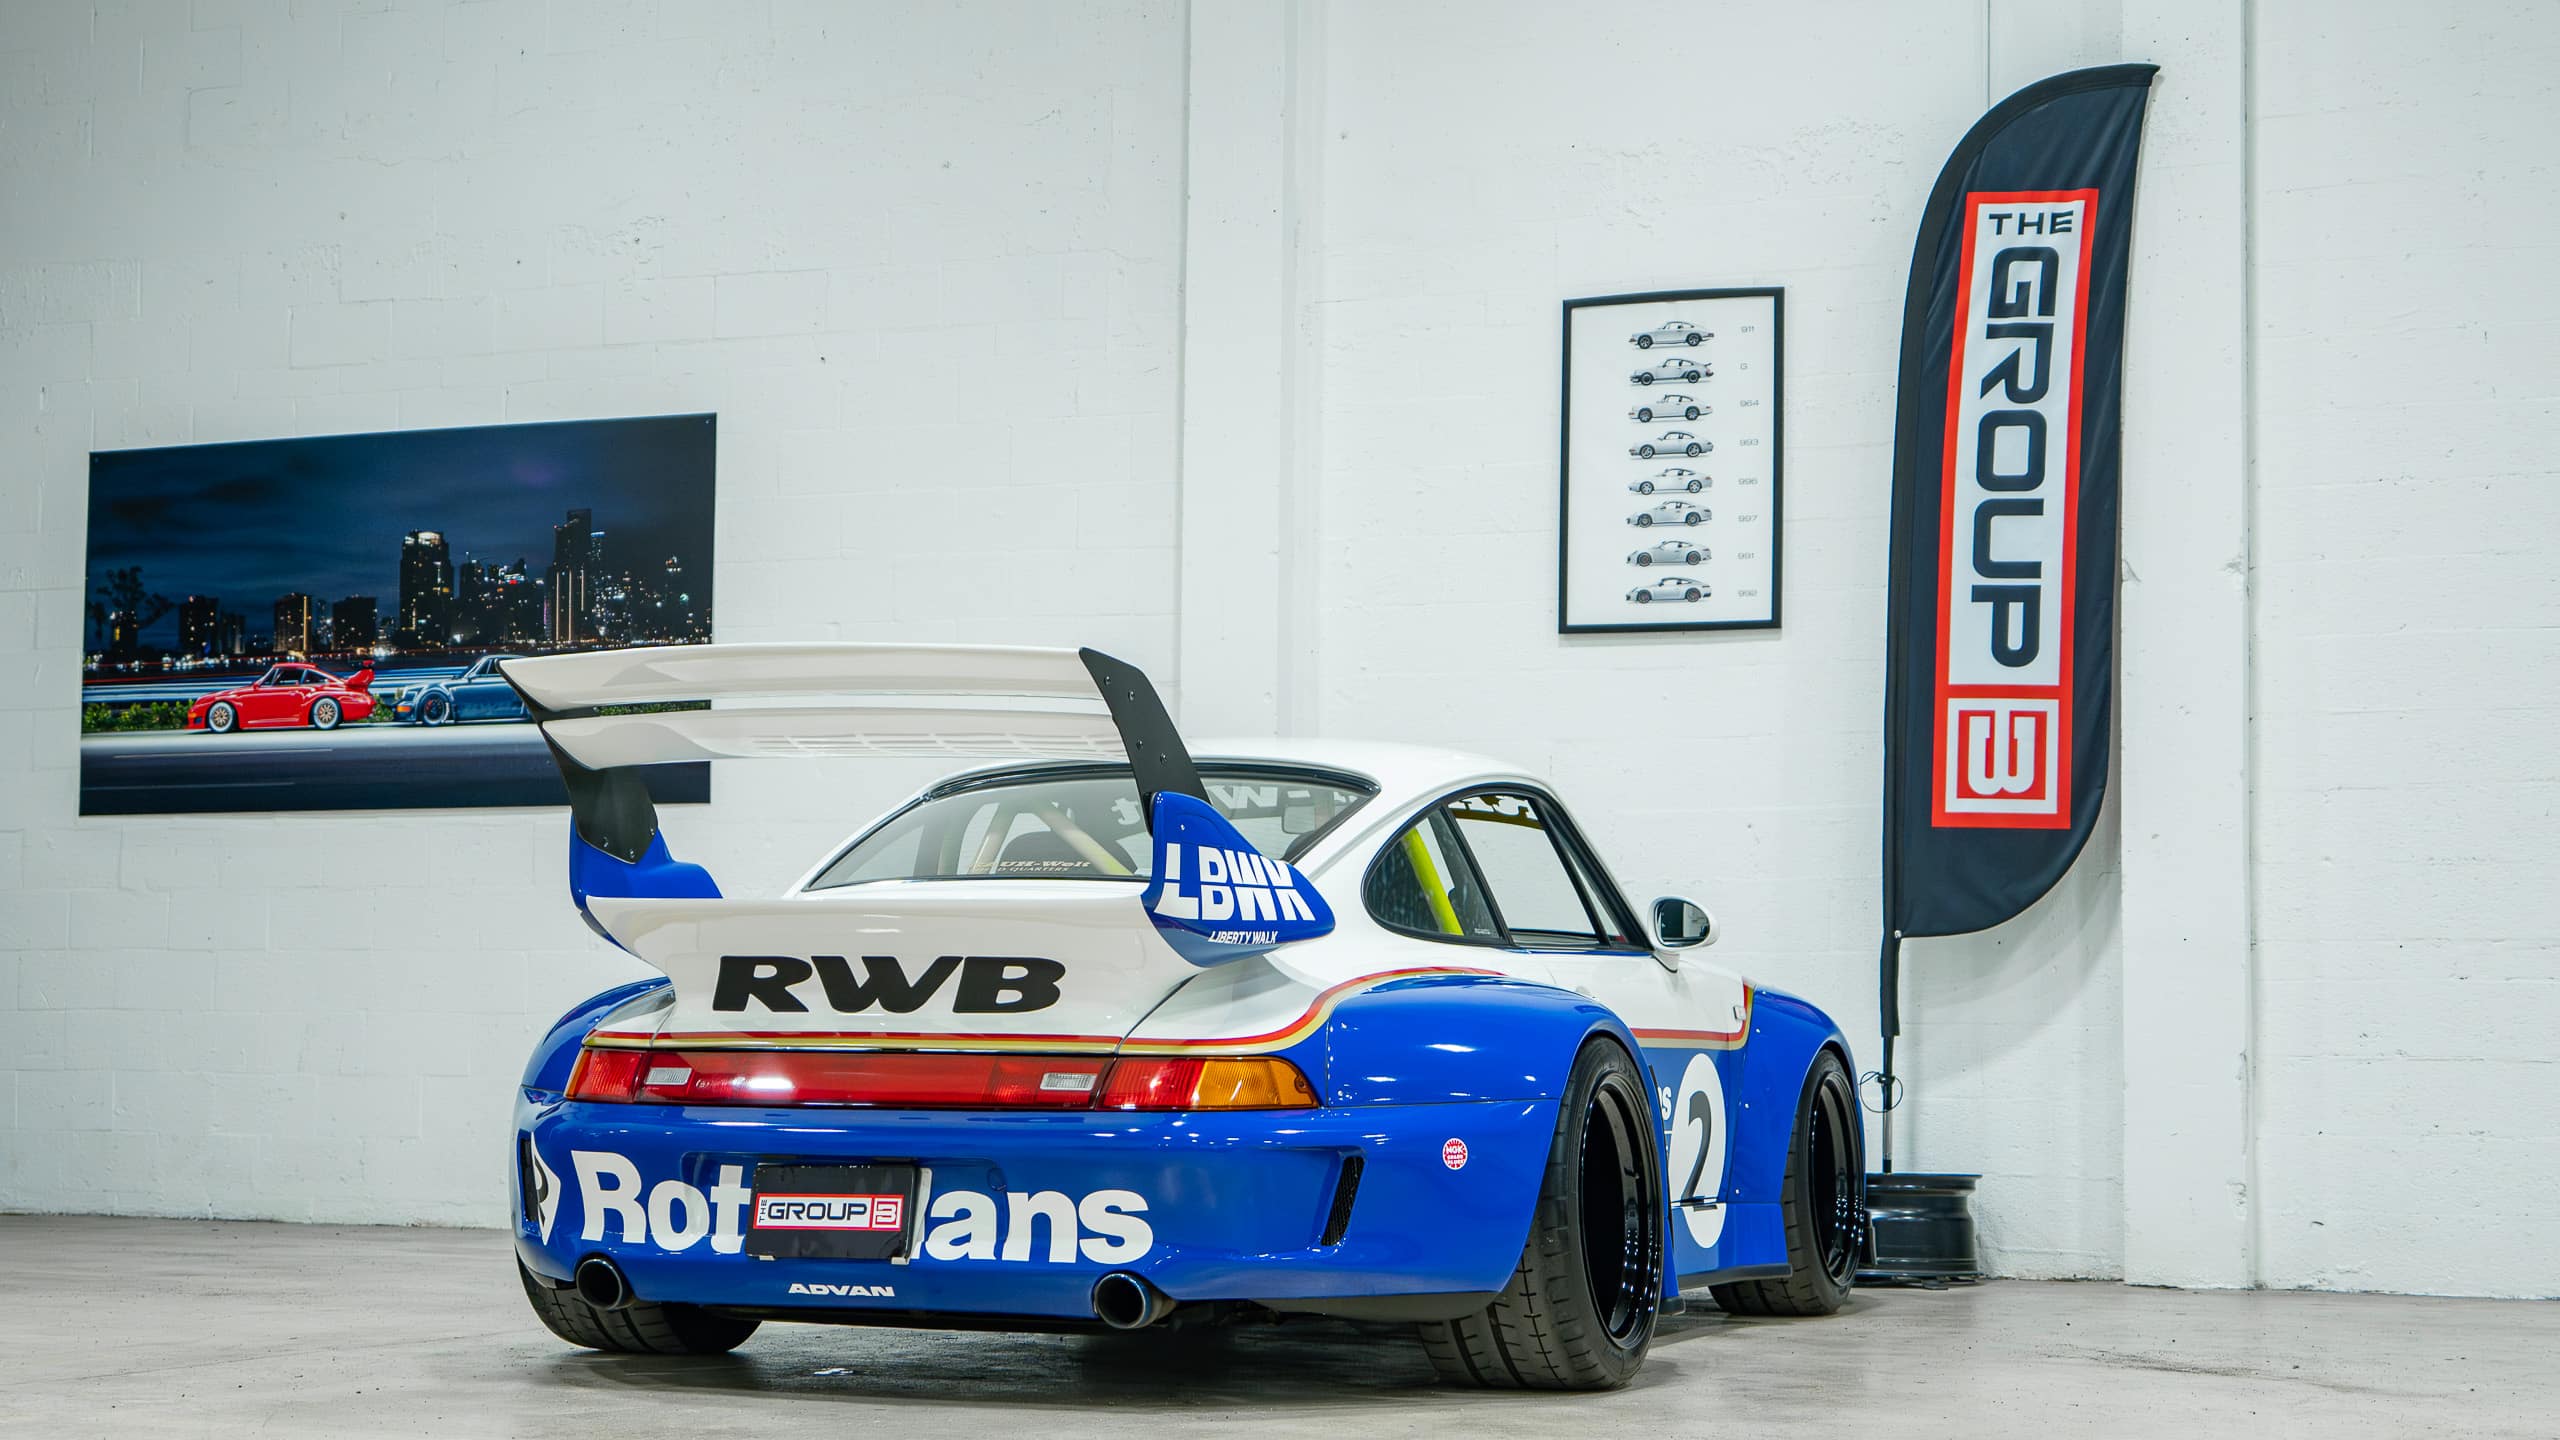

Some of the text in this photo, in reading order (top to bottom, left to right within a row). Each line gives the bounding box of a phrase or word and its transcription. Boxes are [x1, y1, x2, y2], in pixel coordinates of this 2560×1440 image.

[1988, 210, 2074, 235] THE
[1740, 325, 1755, 334] 911
[1971, 246, 2060, 668] GROUP
[1207, 930, 1279, 944] LIBERTY WALK
[712, 956, 1066, 1013] RWB
[1446, 1145, 1464, 1154] NGK
[1679, 1089, 1718, 1211] 2
[571, 1149, 1154, 1264] Rotans
[758, 1199, 897, 1223] THE GROUP 3
[788, 1283, 895, 1297] ADVAN
